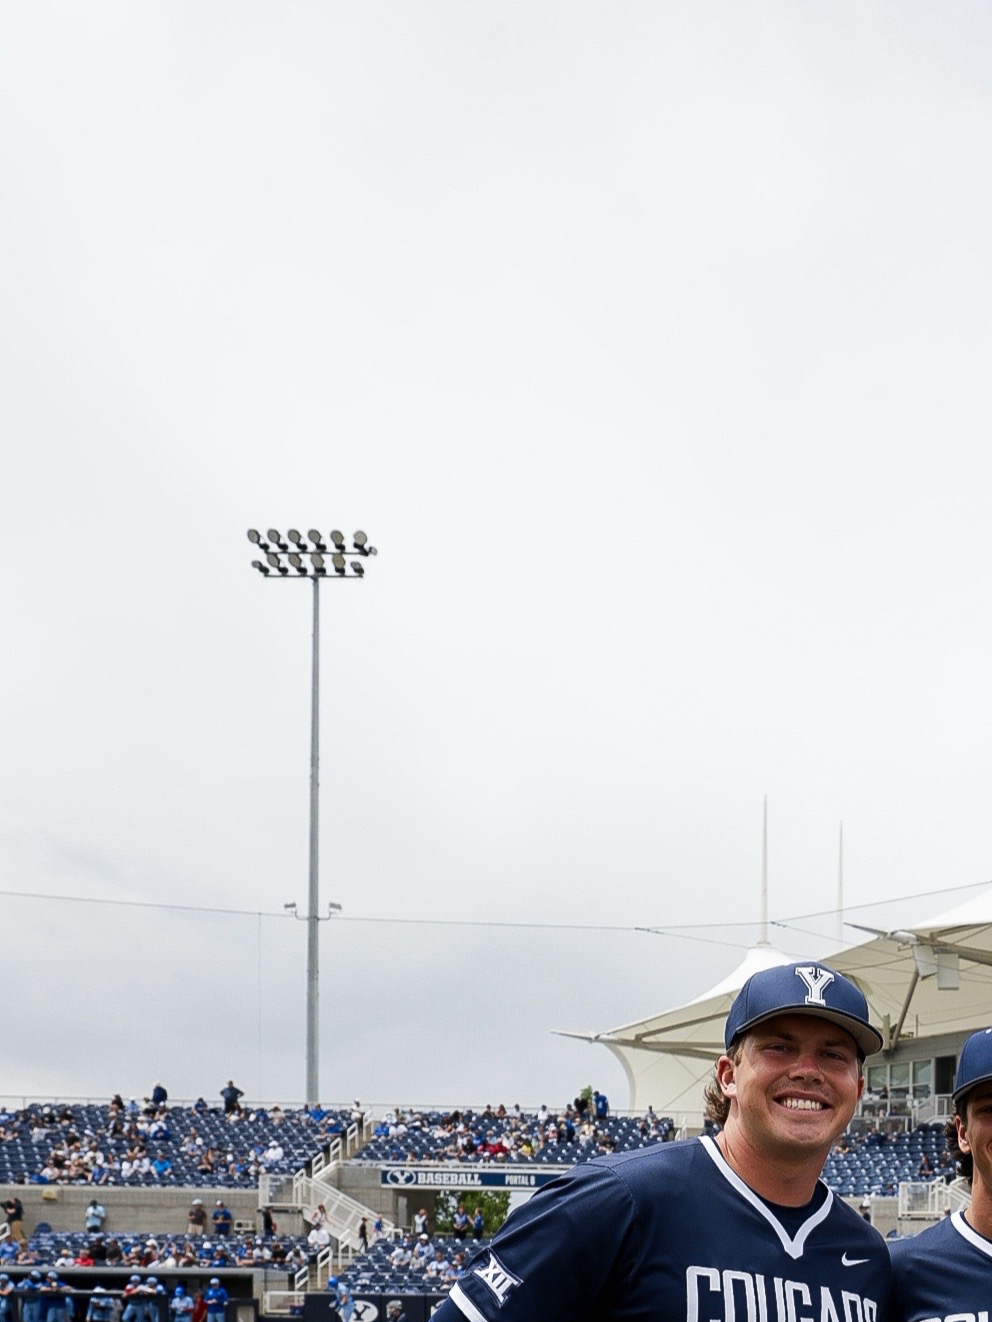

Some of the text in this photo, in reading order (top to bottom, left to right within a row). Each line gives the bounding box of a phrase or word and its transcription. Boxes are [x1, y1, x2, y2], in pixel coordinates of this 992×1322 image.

[795, 966, 834, 1006] Y
[417, 1172, 482, 1186] BASEBALL
[505, 1174, 529, 1186] PORTAL
[473, 1251, 521, 1305] XII
